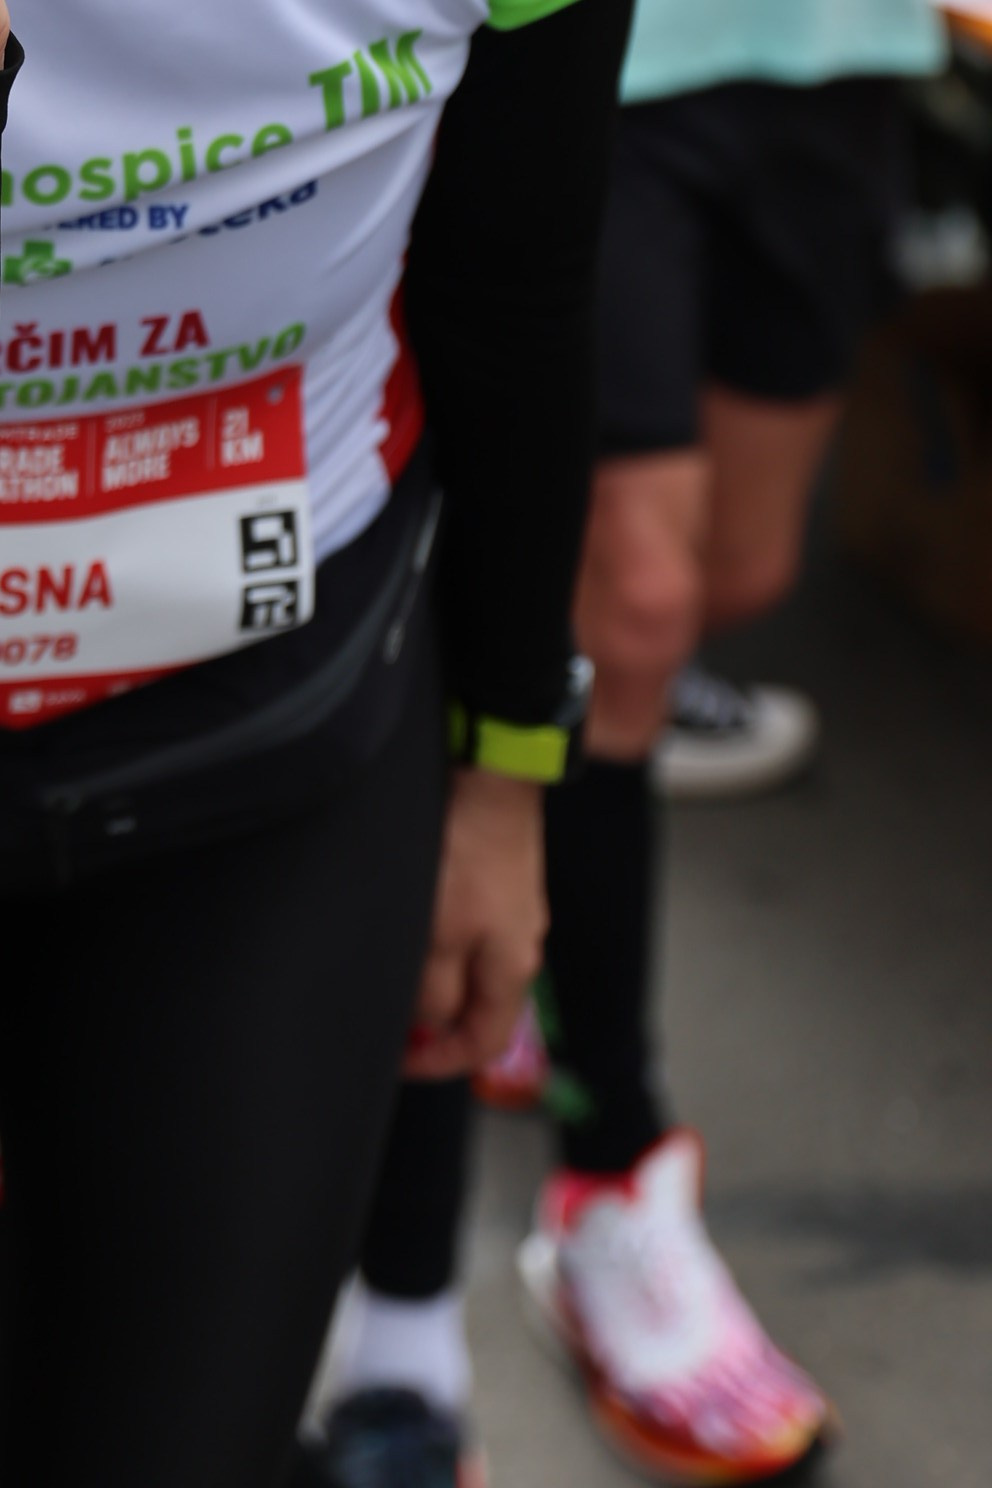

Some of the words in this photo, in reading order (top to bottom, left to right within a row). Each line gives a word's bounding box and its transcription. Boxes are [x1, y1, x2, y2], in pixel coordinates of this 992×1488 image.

[308, 27, 433, 131] TIM
[147, 202, 190, 231] BY
[139, 307, 211, 359] ZA
[220, 429, 265, 468] KM
[101, 453, 171, 492] MORE
